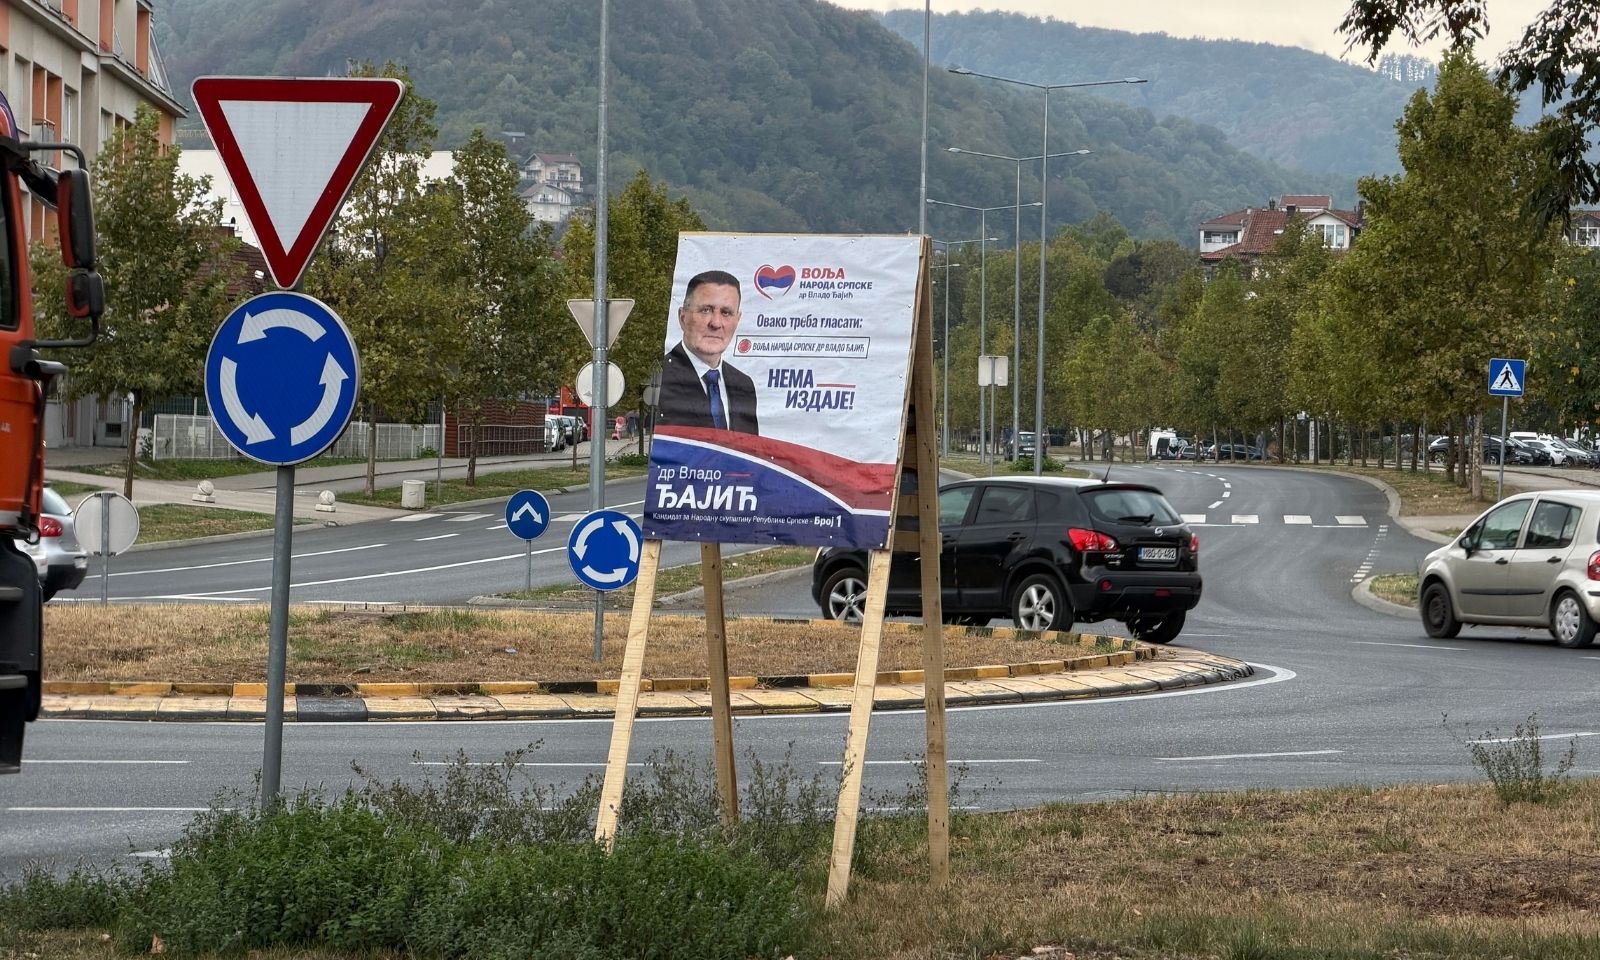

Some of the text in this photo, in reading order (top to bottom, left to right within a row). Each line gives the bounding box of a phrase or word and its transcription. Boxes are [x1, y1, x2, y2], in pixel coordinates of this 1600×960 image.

[801, 268, 845, 279] ВОЉА
[800, 281, 873, 290] НАРОДА СРПСКЕ
[808, 291, 831, 299] Владо
[832, 291, 853, 300] Ђајић
[757, 314, 863, 330] Овако треба гласати:
[752, 342, 770, 351] ВОЉА
[771, 342, 793, 352] НАРОДА
[793, 343, 816, 352] СРПСКЕ
[825, 343, 845, 353] ВЛАДО
[767, 368, 814, 388] НЕМА
[785, 390, 855, 412] ИЗДАЈЕ!
[658, 466, 721, 482] др Владо
[655, 483, 758, 511] ЂАЈИЋ
[691, 514, 718, 522] Народну
[752, 515, 785, 525] Републике
[786, 517, 808, 525] Српске
[814, 516, 835, 527] Број
[836, 515, 842, 527] 1
